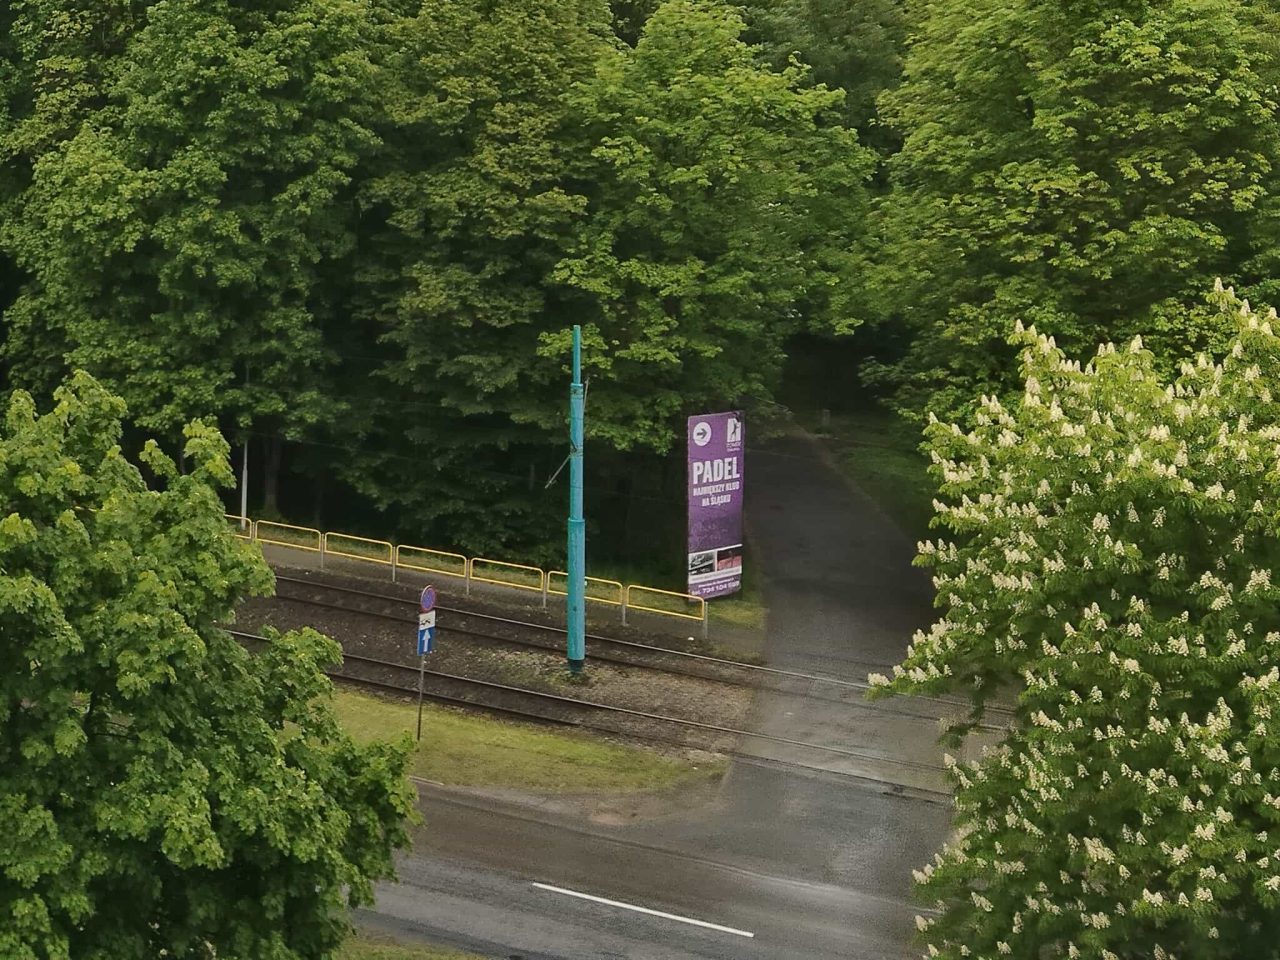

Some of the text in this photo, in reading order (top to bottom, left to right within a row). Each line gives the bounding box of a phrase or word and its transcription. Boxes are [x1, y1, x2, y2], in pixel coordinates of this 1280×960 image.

[693, 457, 740, 484] PADEL
[701, 493, 731, 507] NA ŚLĄSKU
